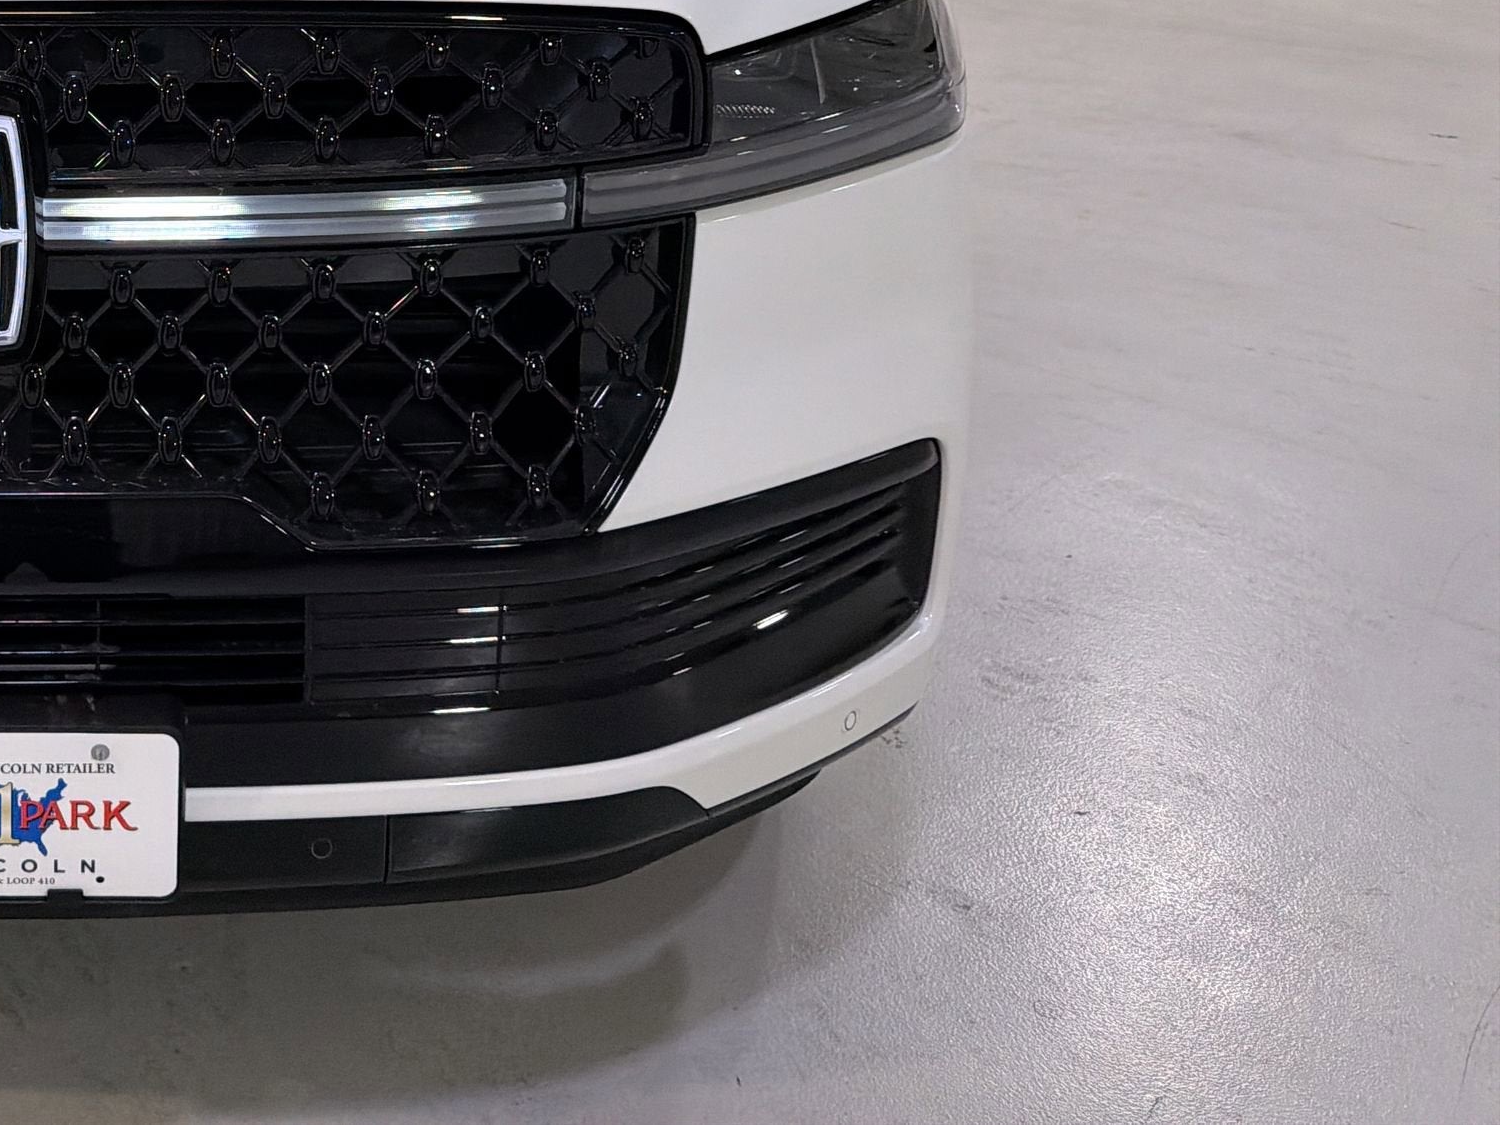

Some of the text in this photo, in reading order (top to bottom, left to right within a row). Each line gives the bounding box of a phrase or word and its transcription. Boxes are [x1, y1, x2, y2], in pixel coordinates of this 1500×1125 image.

[45, 763, 115, 775] RETAILER
[19, 800, 139, 831] PARK
[7, 876, 36, 885] LOOP
[38, 877, 56, 886] 410
